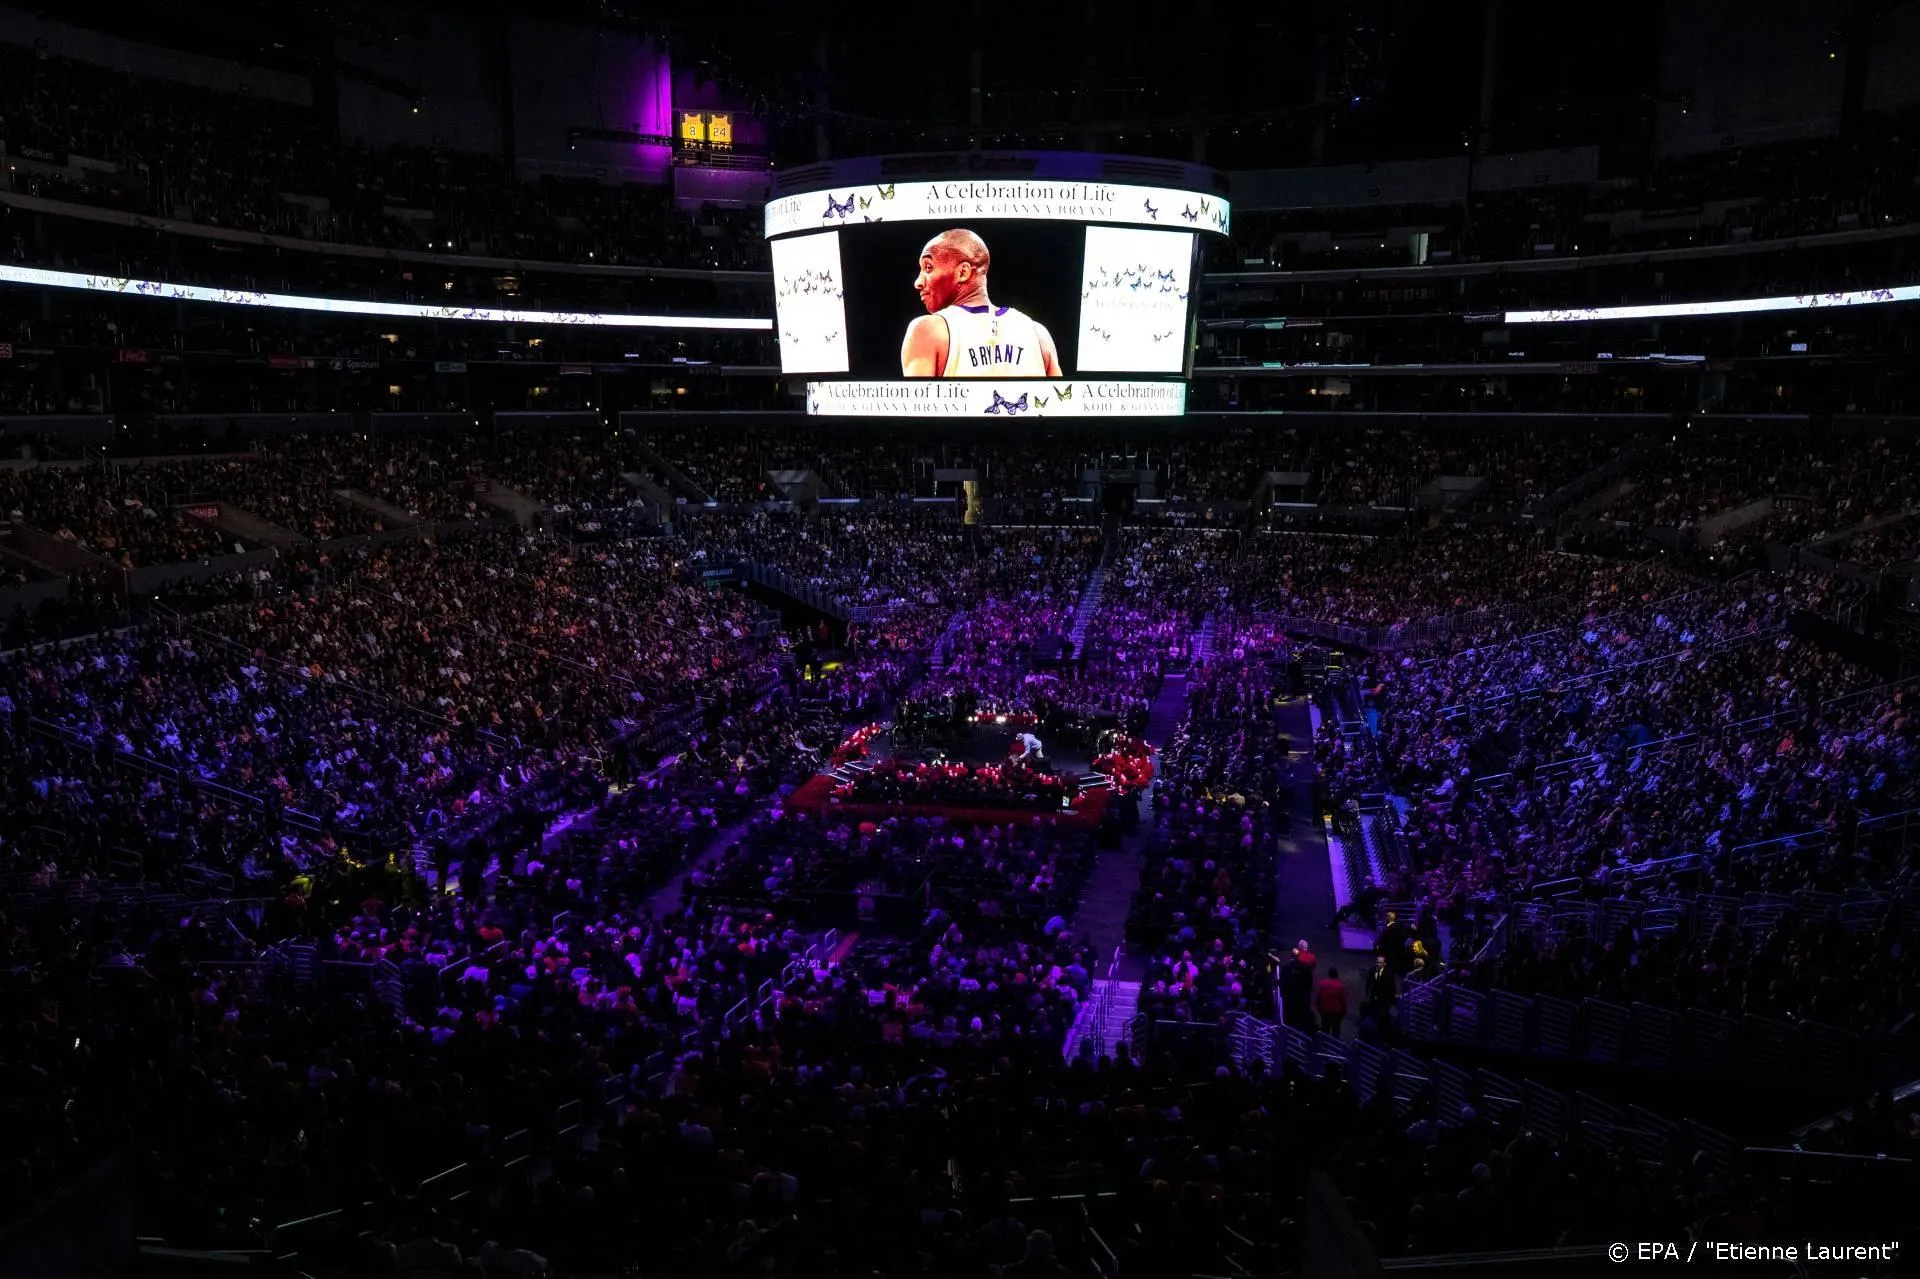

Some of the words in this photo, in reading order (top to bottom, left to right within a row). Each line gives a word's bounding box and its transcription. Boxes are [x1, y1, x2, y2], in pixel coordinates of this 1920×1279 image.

[690, 126, 697, 137] 8
[713, 127, 727, 138] 24
[927, 184, 941, 200] A
[945, 182, 1055, 199] Celebration
[1059, 183, 1079, 200] of
[1083, 184, 1117, 202] Life
[928, 203, 968, 215] KOBE
[975, 203, 984, 213] &
[968, 344, 1025, 368] BRYANT
[835, 383, 909, 399] Celebration
[914, 383, 932, 398] of
[936, 383, 971, 399] Life
[1082, 383, 1094, 398] A
[1097, 383, 1165, 398] Celebration
